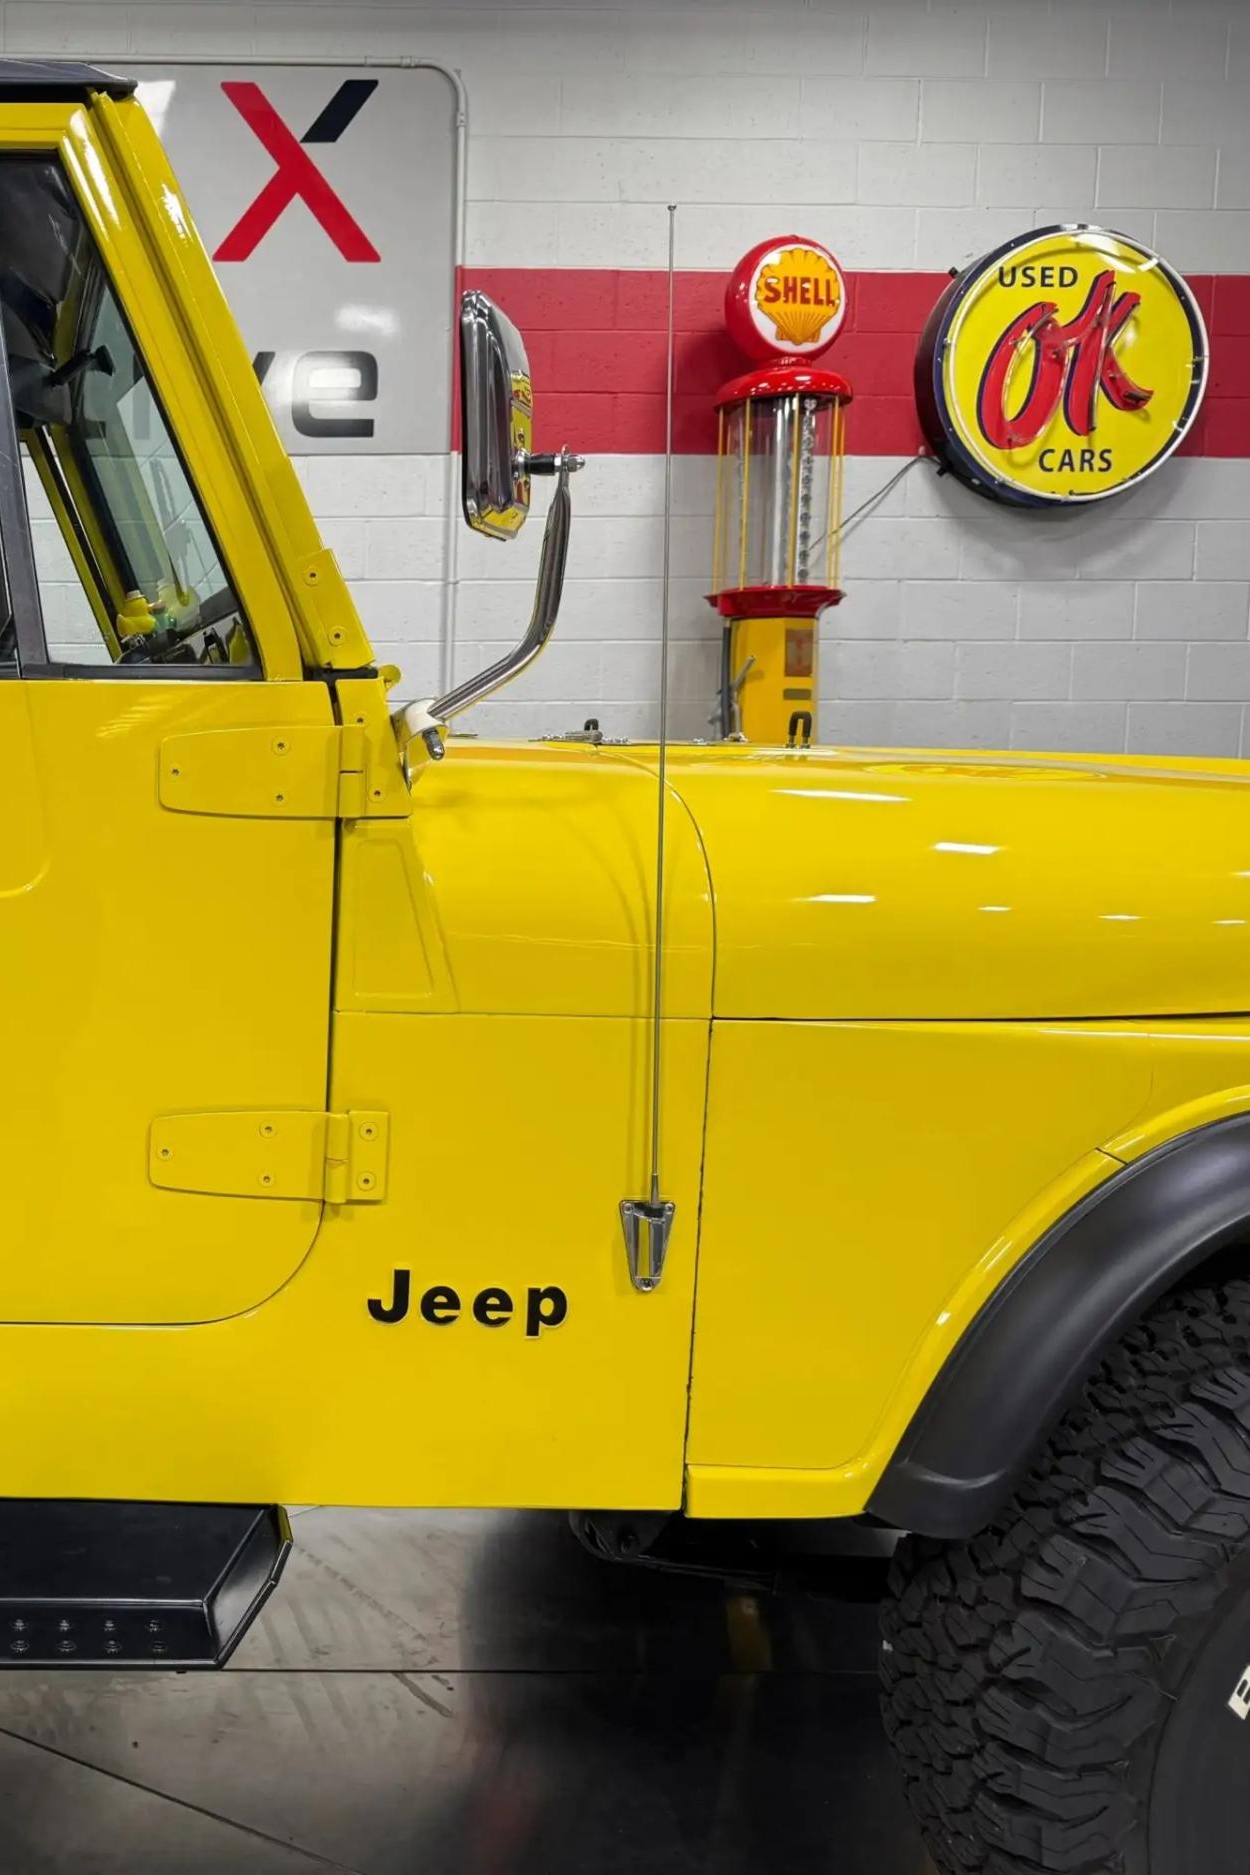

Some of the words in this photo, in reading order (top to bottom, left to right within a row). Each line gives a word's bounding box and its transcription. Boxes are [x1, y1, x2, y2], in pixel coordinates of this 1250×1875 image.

[763, 275, 836, 307] SHELL
[998, 266, 1078, 288] USED
[1038, 448, 1112, 472] CARS
[367, 1268, 568, 1337] Jeep
